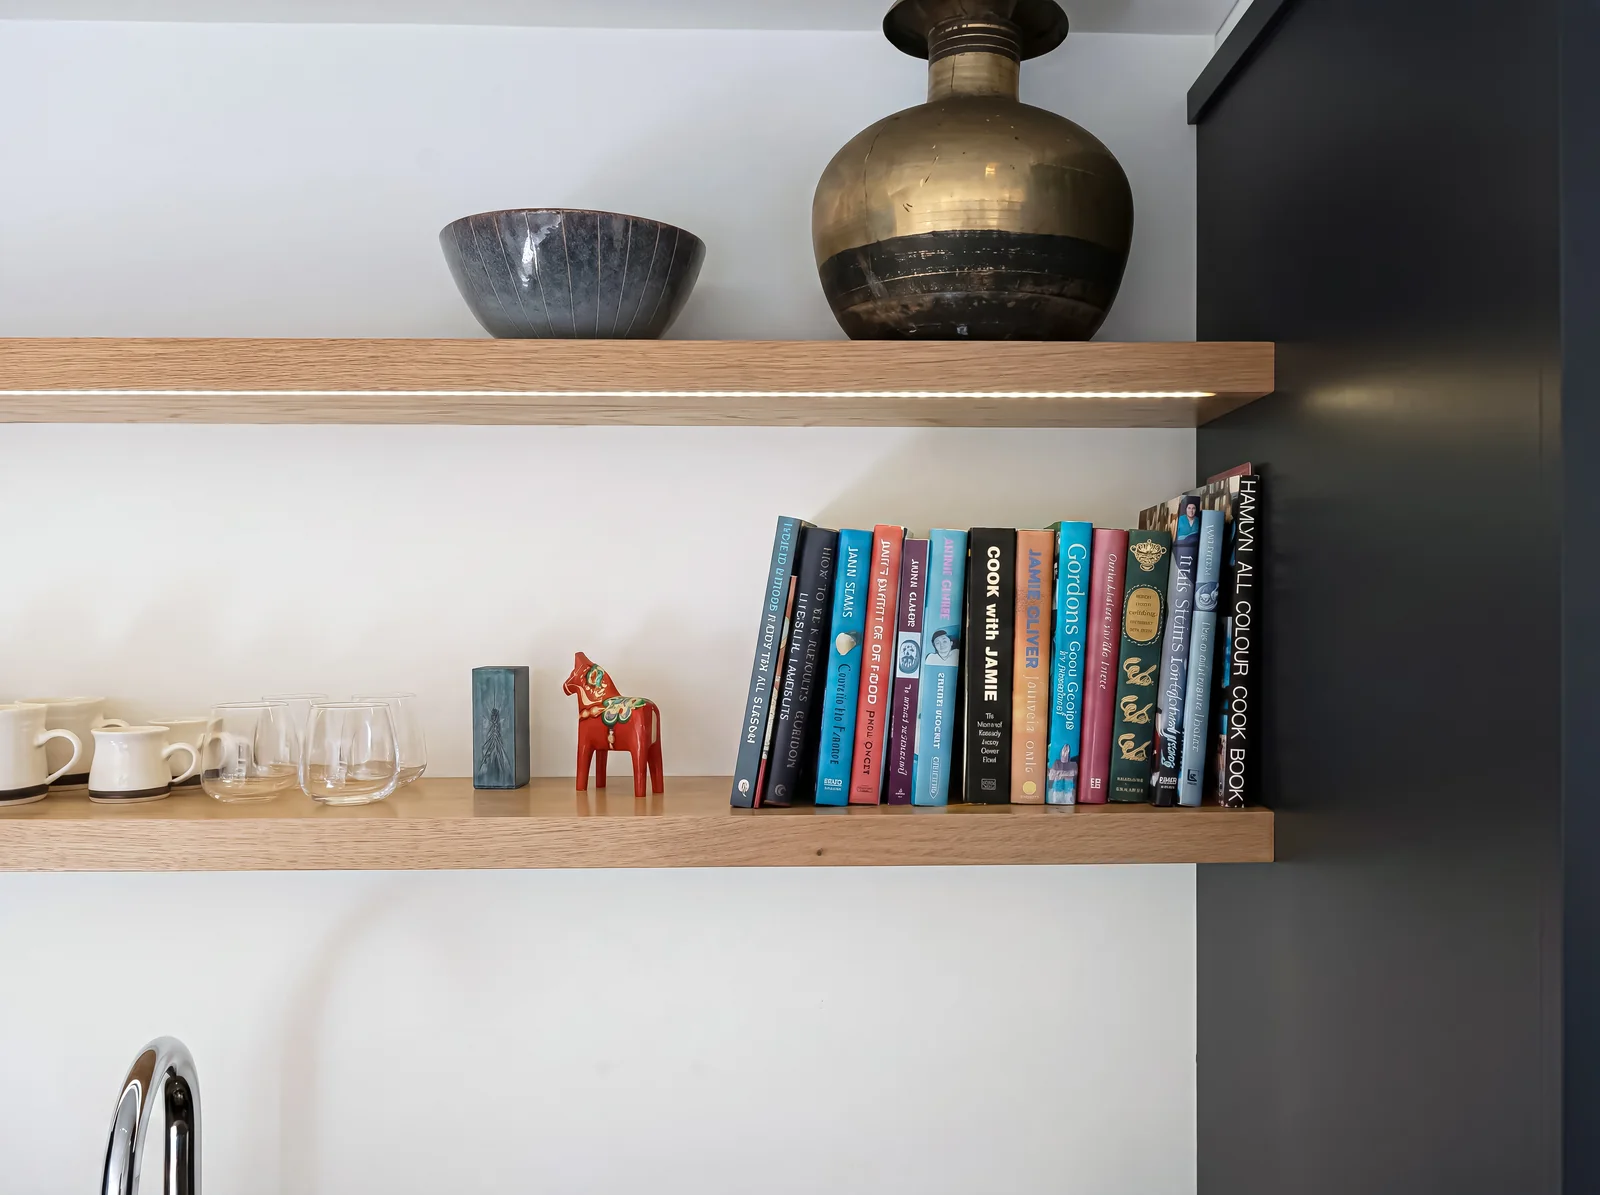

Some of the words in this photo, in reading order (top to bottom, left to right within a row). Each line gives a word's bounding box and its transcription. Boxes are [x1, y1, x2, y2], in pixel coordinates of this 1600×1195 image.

[1237, 480, 1256, 552] HAMLYN
[986, 546, 1001, 598] COOK
[1027, 548, 1042, 600] JAMIE
[1064, 543, 1087, 635] Gordons
[1236, 561, 1253, 594] ALL
[985, 603, 999, 640] with
[1233, 601, 1252, 675] COLOUR
[984, 646, 999, 701] JAMIE
[1230, 686, 1248, 739] COOK
[1228, 748, 1245, 802] BOOK
